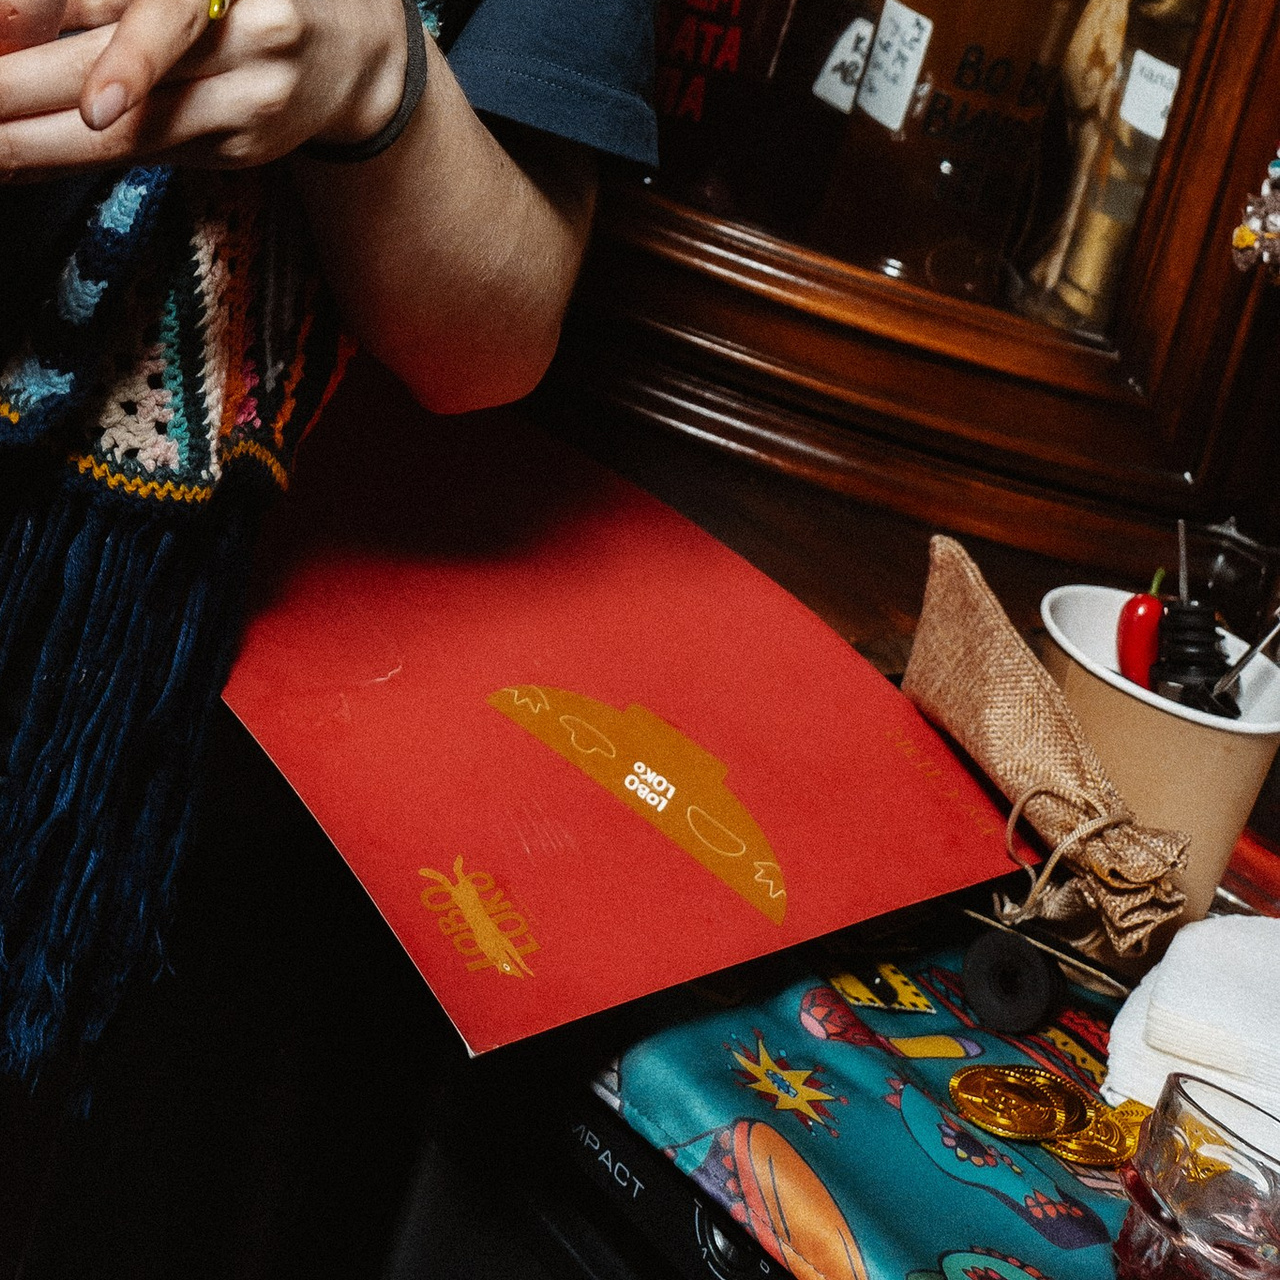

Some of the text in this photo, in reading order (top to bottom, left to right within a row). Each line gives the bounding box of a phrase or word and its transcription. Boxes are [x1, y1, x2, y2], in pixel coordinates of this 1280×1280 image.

[624, 774, 668, 812] LOBO
[633, 761, 676, 799] LOKO
[465, 871, 541, 956] LOKO
